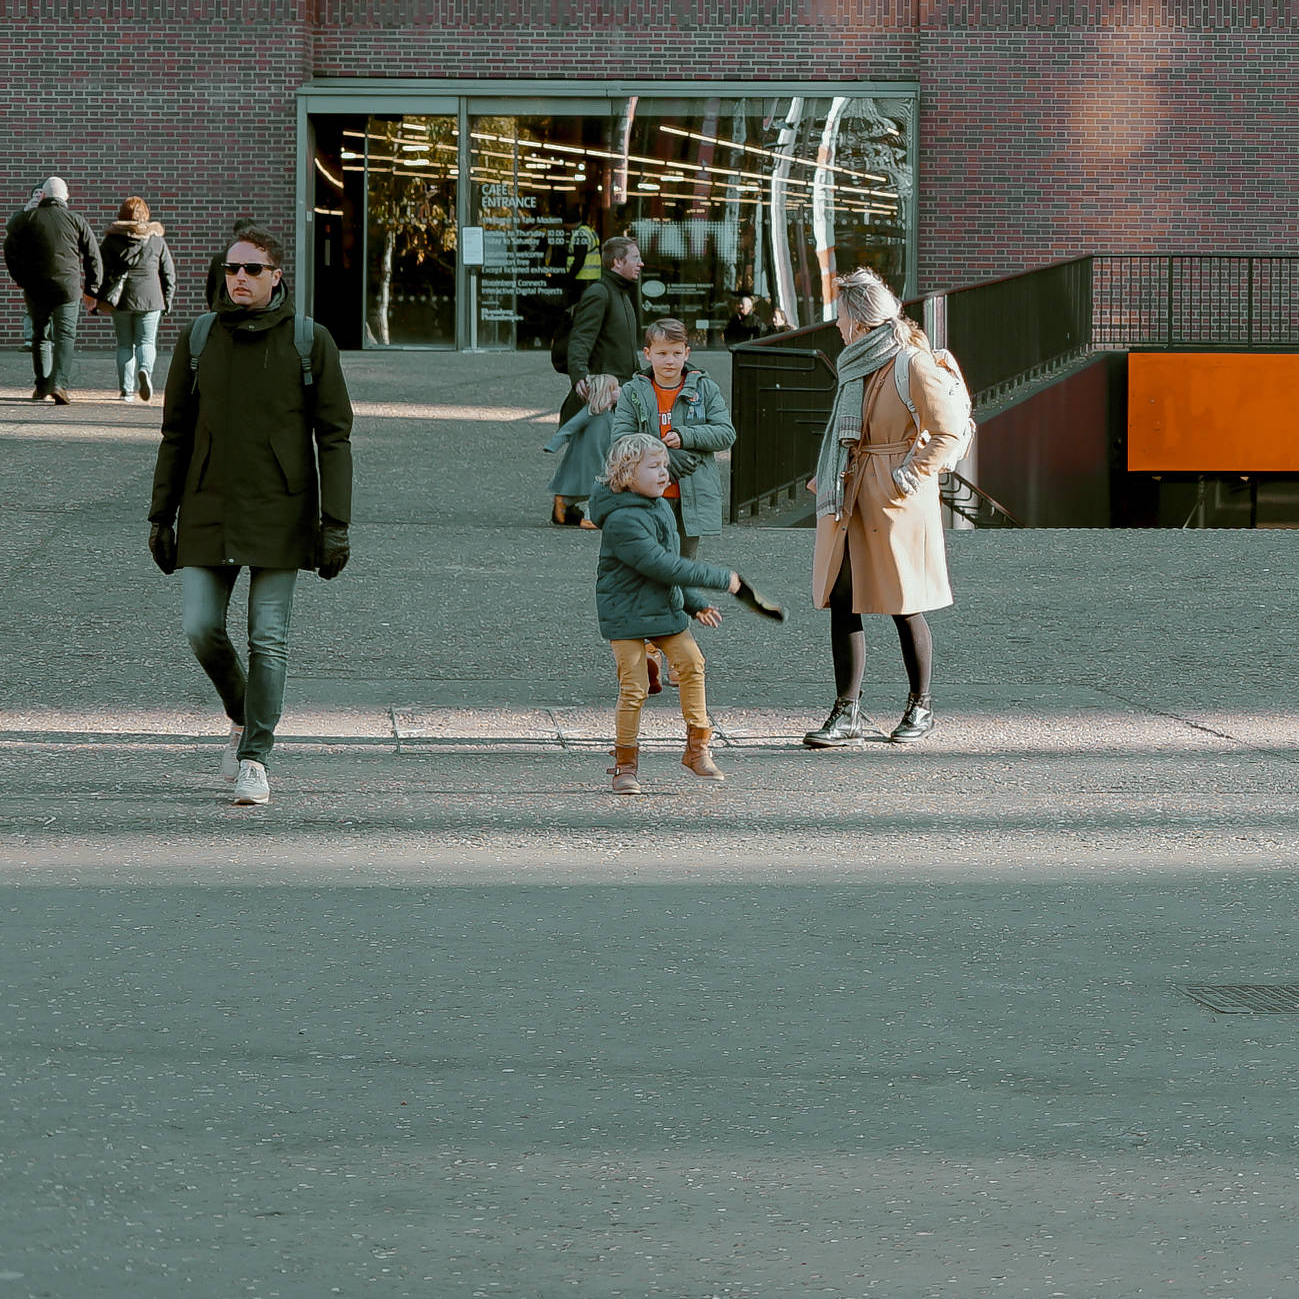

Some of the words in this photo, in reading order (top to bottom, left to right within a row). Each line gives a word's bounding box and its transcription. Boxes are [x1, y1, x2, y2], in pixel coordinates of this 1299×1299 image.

[482, 196, 537, 208] ENTRANCE
[521, 216, 535, 224] Tate
[537, 216, 563, 224] Modern
[516, 229, 546, 239] Thursday
[511, 237, 540, 246] Saturday
[517, 279, 548, 288] Connects
